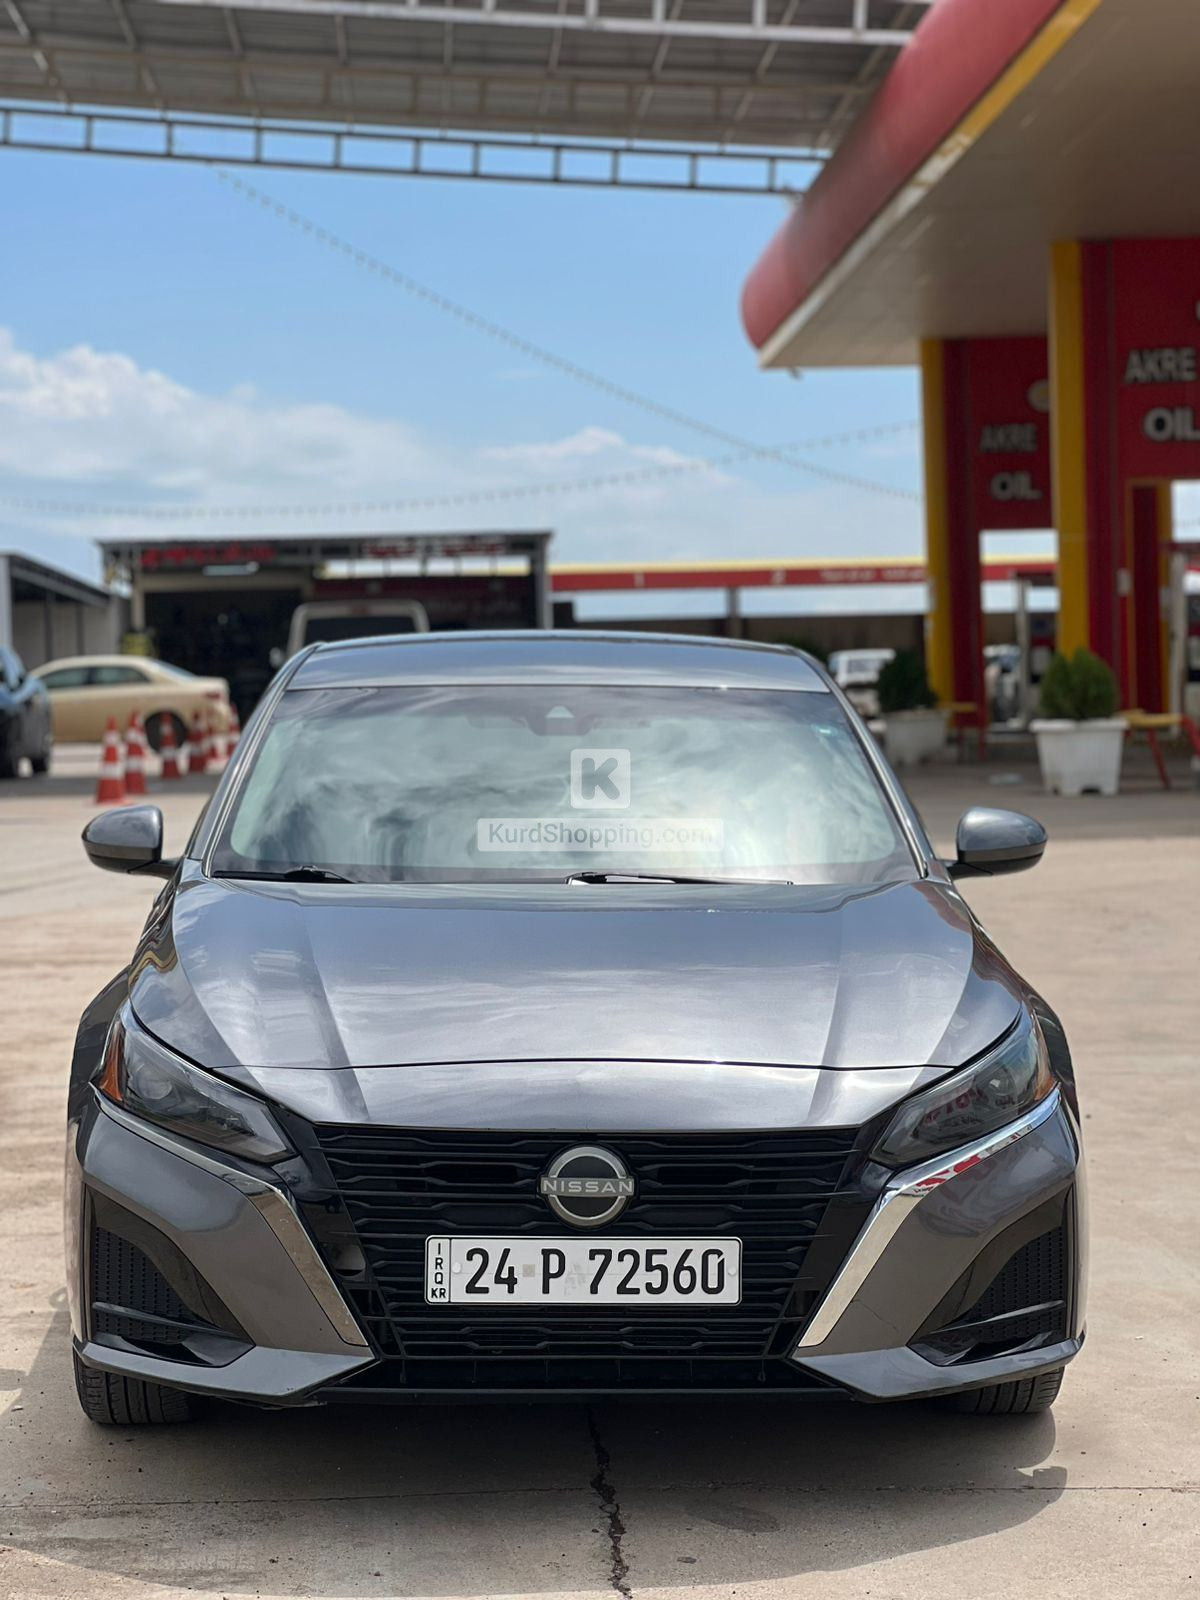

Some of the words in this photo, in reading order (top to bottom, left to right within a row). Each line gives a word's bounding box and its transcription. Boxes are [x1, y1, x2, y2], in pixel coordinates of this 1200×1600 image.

[1126, 348, 1196, 382] AKRE
[980, 424, 1036, 452] AKRE
[1144, 407, 1200, 441] OIL
[991, 472, 1042, 500] OIL
[542, 1179, 634, 1194] NISSAN
[465, 1247, 518, 1294] 24
[541, 1248, 566, 1295] P
[588, 1248, 726, 1295] 72560
[431, 1287, 447, 1299] KR
